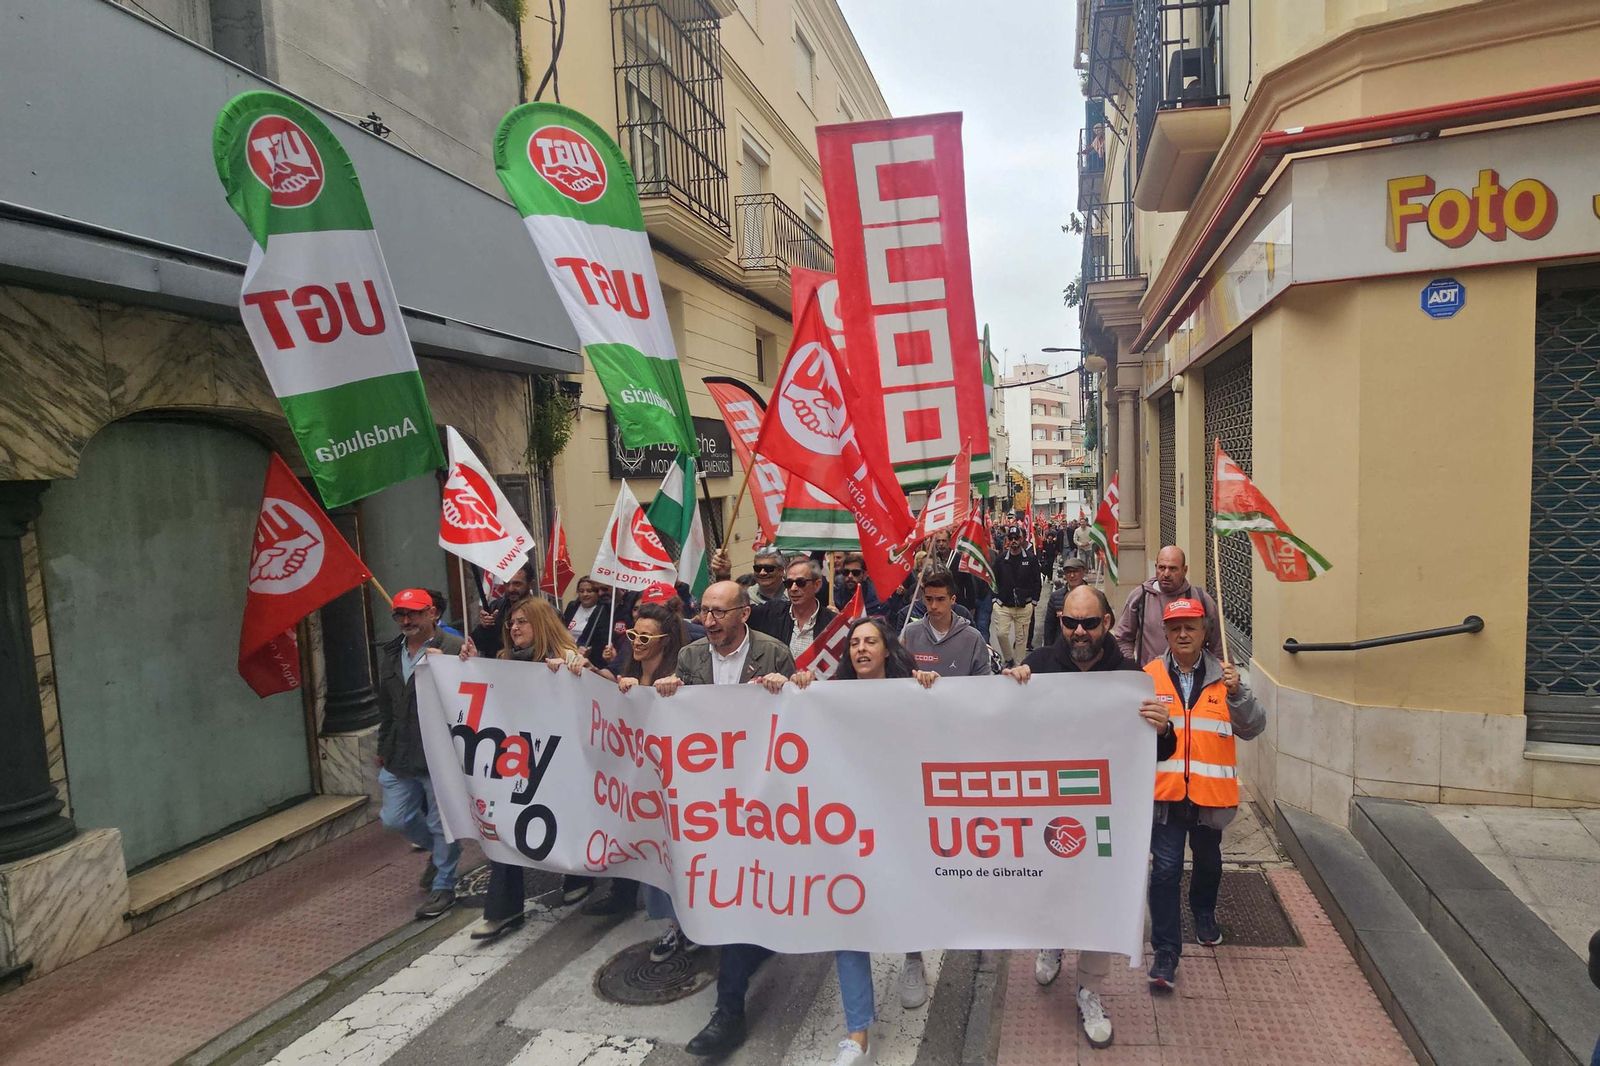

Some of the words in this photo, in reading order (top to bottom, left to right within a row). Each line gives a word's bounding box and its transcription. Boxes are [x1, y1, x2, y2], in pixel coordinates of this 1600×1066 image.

[1385, 168, 1558, 253] Foto
[851, 135, 961, 465] CCOO
[1428, 288, 1459, 304] ADT
[590, 699, 746, 790] Proteger
[764, 713, 809, 775] lo
[930, 769, 1050, 798] CCOO
[928, 816, 1034, 859] UGT
[685, 852, 866, 917] futuro
[934, 866, 974, 879] Campo
[976, 867, 990, 878] de
[992, 866, 1044, 878] Gibraltar
